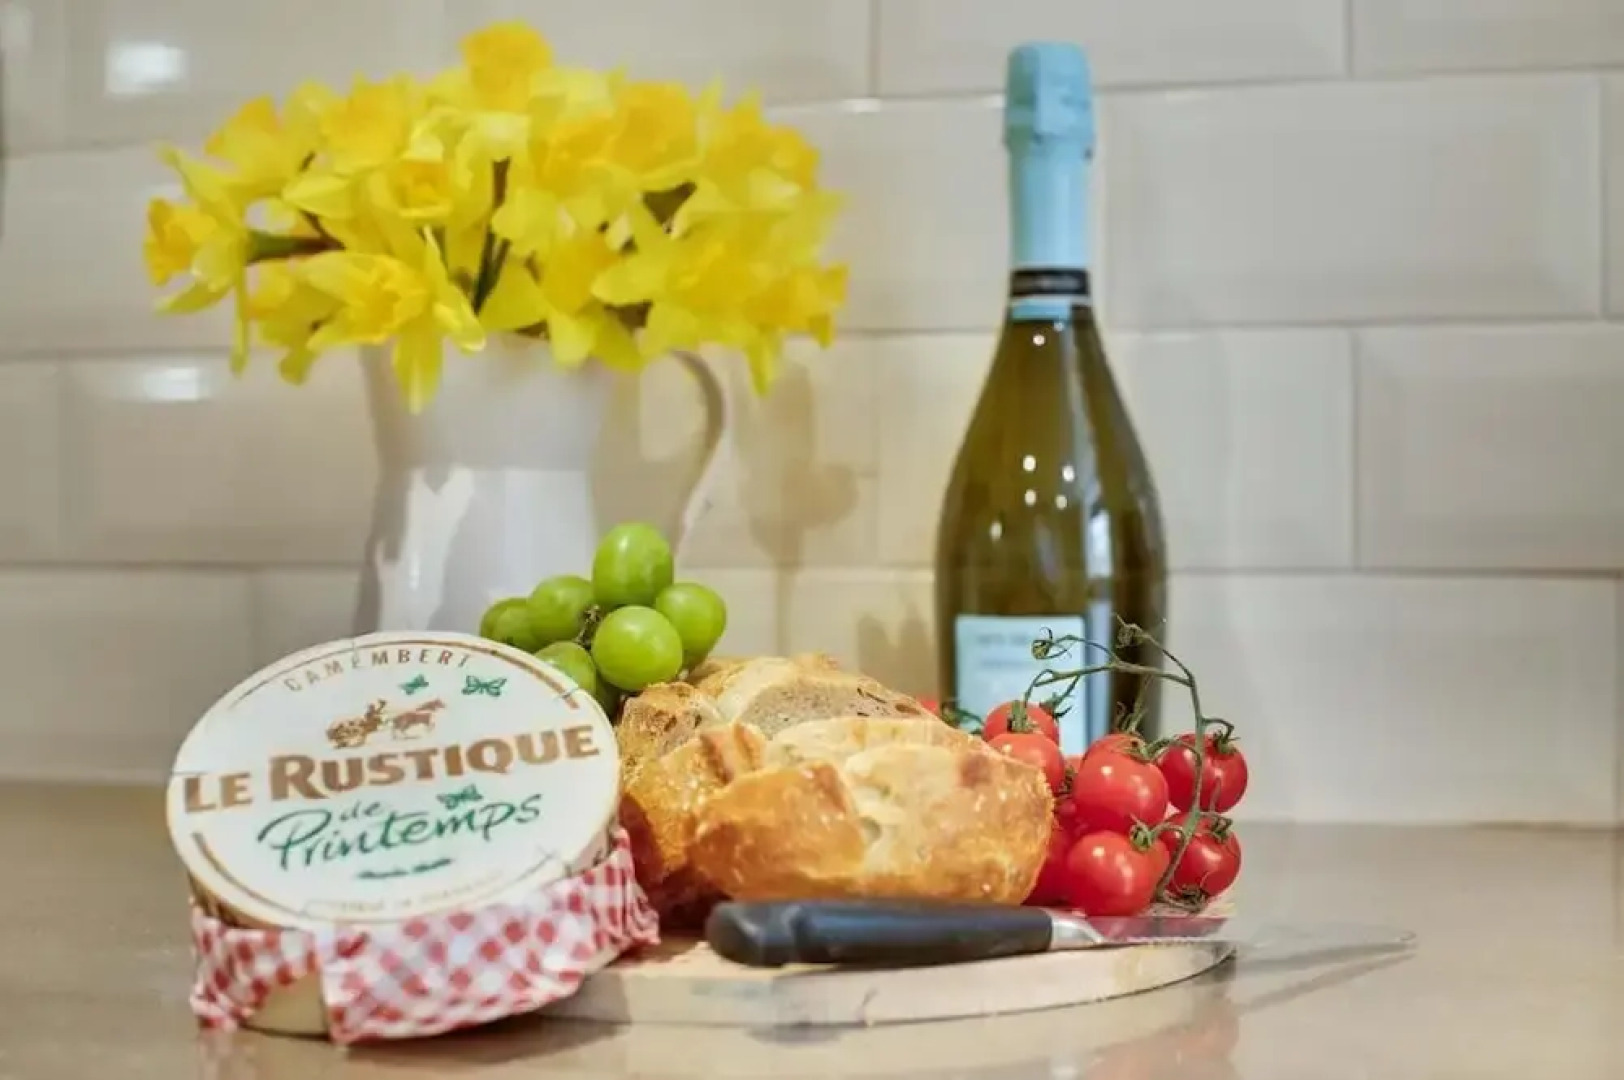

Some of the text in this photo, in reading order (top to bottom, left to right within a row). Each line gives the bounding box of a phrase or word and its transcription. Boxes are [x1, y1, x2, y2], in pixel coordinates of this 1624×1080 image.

[284, 648, 470, 692] CAMEMBERT
[183, 726, 600, 814] LE RUSTIQUE
[257, 794, 543, 870] Printemps
[339, 801, 383, 822] de
